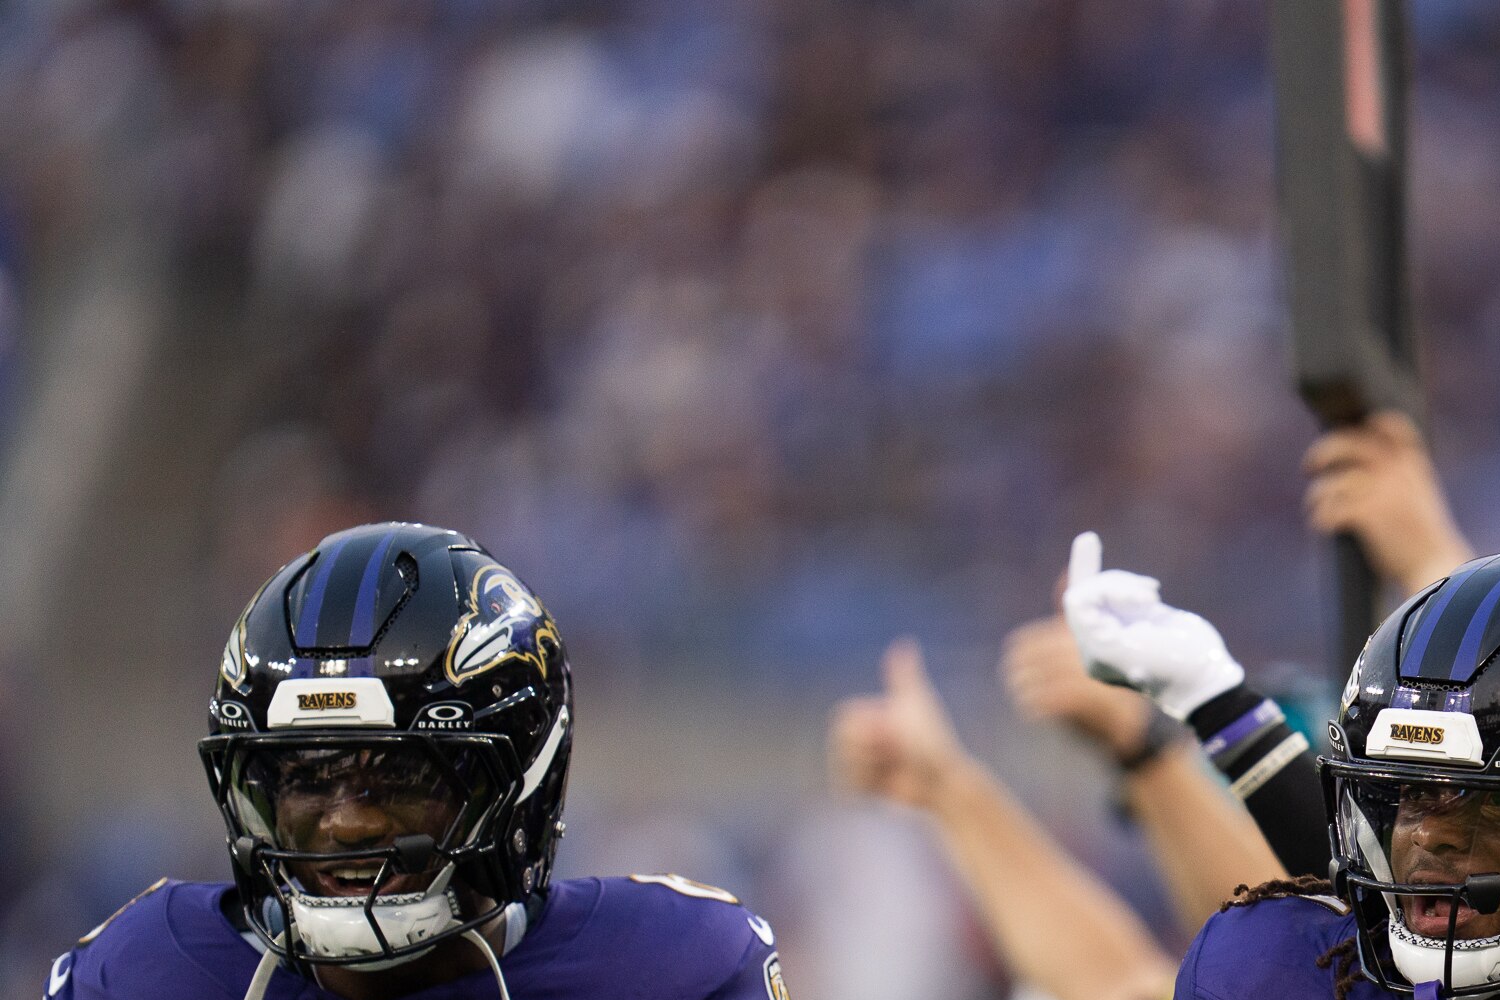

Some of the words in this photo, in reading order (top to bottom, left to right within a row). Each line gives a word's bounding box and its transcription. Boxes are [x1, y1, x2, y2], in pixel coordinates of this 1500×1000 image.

[297, 692, 356, 711] RAVENS
[418, 720, 471, 729] OAKLEY
[1390, 723, 1445, 745] RAVENS
